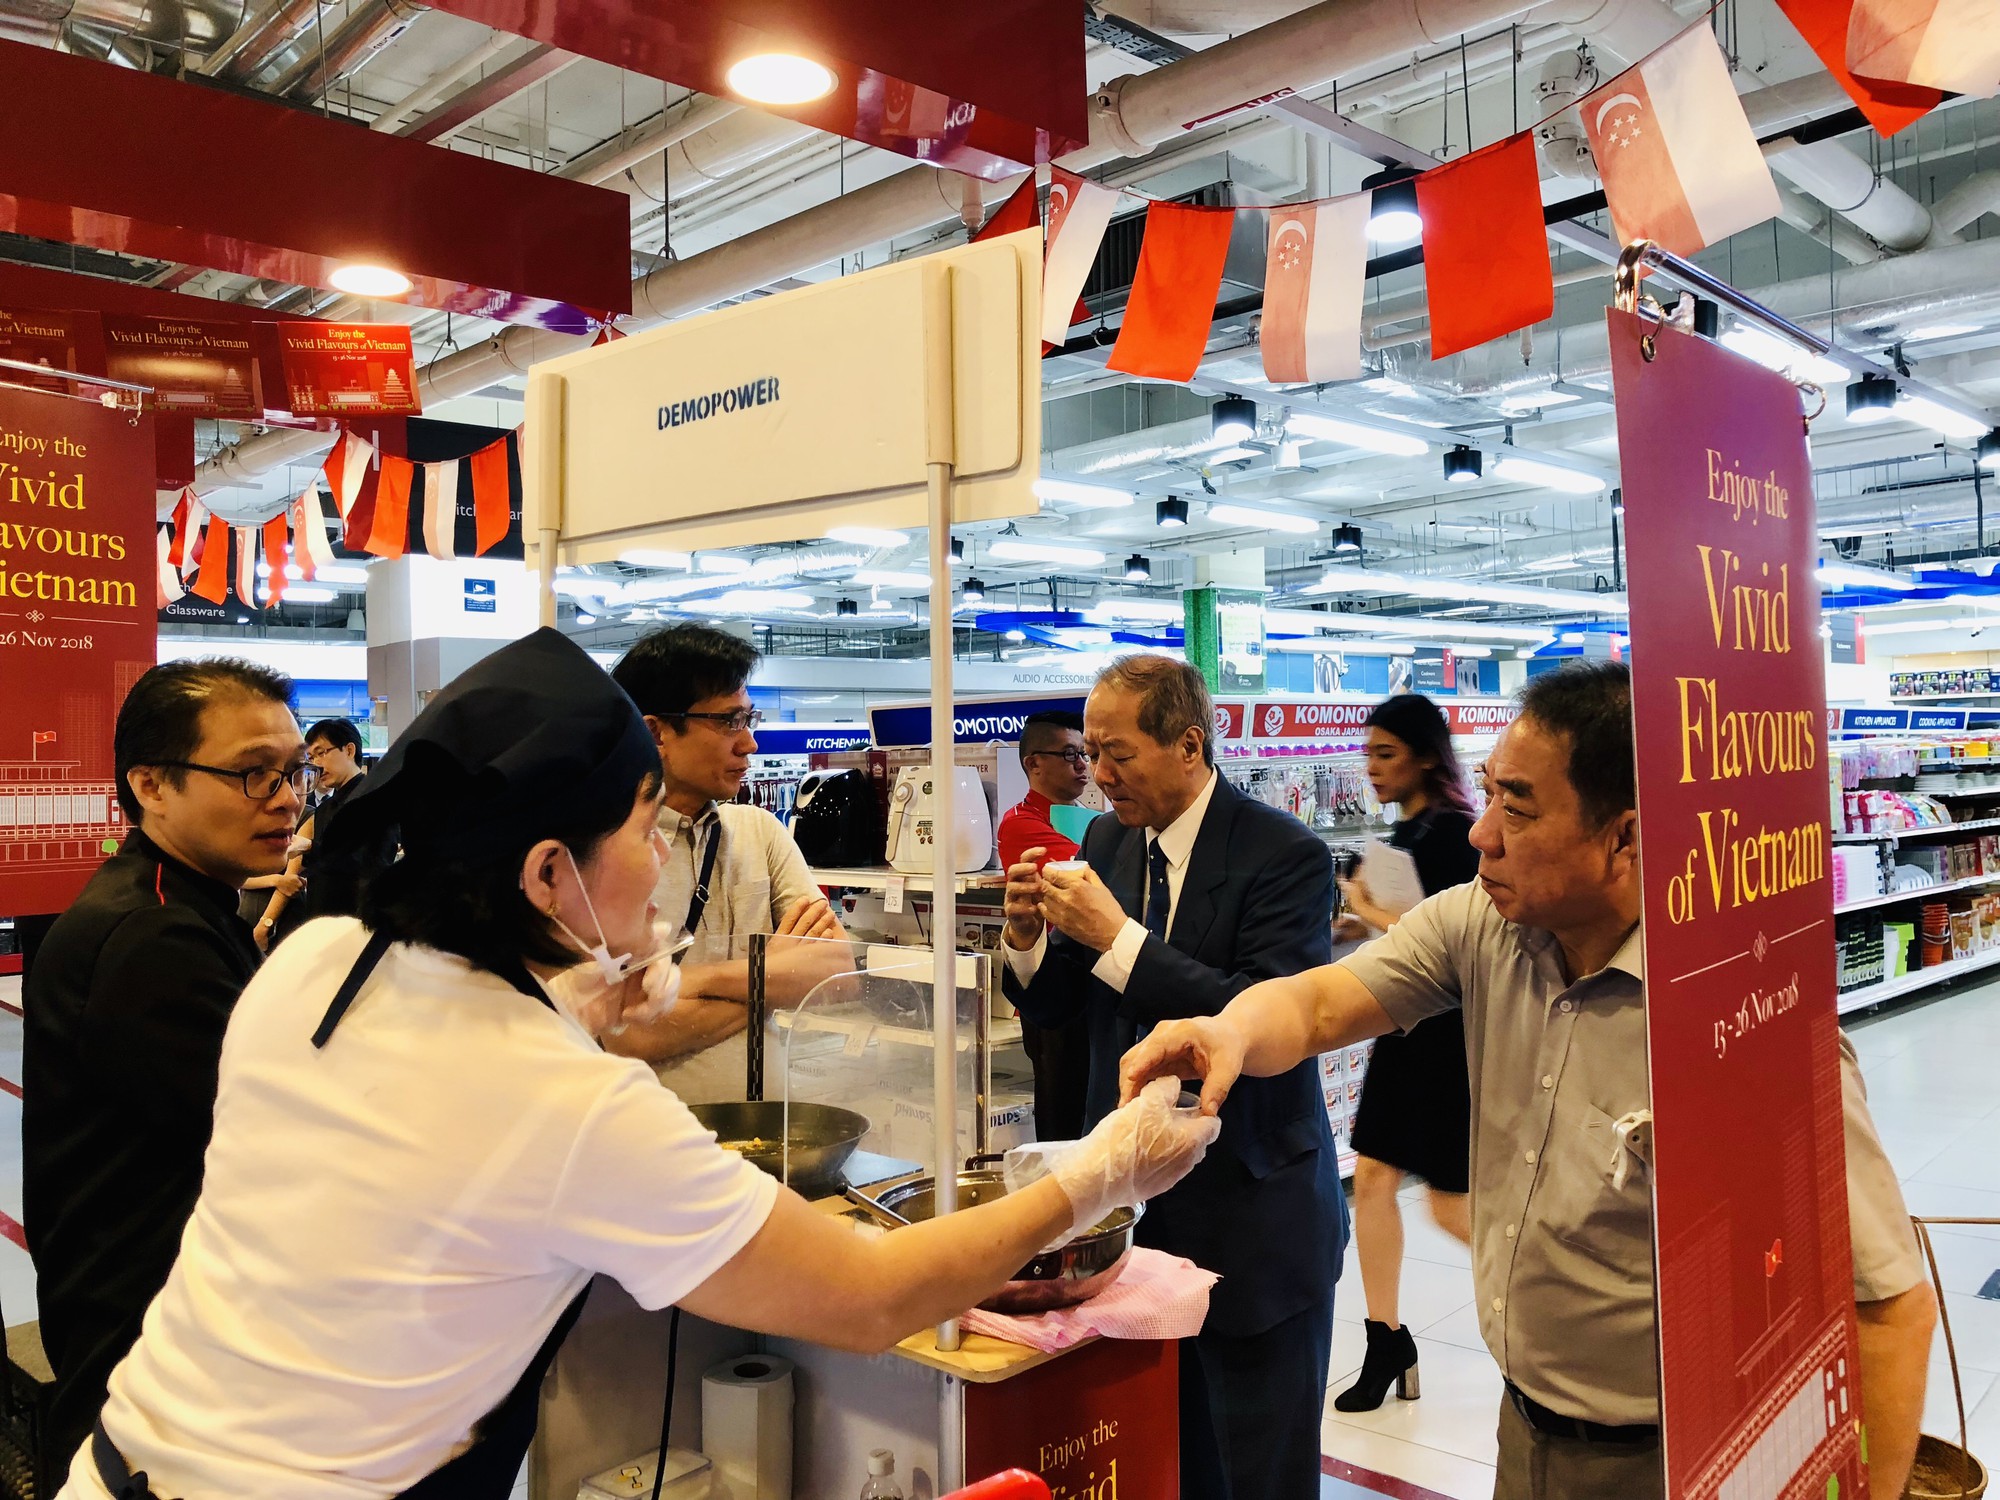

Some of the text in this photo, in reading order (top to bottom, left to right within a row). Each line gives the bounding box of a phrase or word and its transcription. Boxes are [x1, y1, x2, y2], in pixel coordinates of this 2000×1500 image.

[0, 310, 12, 320] he
[13, 322, 65, 337] Vietnam
[158, 323, 201, 335] Enjoy the
[328, 329, 366, 340] Enjoy the
[111, 331, 142, 343] Vivid
[145, 332, 194, 346] Flavours
[203, 336, 249, 349] Vietnam
[287, 338, 314, 349] Vivid
[316, 338, 359, 350] Flavours
[366, 339, 406, 351] Vietnam
[658, 376, 780, 430] DEMOPOWER
[54, 436, 87, 458] the
[1706, 448, 1789, 526] Enjoy the
[0, 521, 126, 561] avours
[0, 559, 138, 607] ietnam
[1696, 544, 1791, 654] Vivid
[166, 603, 226, 617] Glassware
[21, 631, 56, 648] Nov
[61, 635, 93, 650] 2018
[1446, 652, 1452, 666] 3
[1013, 673, 1041, 684] AUDIO
[1458, 706, 1519, 724] KOMONO
[953, 715, 1029, 736] OMOTION
[1314, 727, 1366, 736] OSAKA JAPAN
[1473, 725, 1493, 734] OSAKA
[1675, 676, 1816, 784] Flavours
[806, 737, 873, 749] KITCHENWA
[1667, 808, 1824, 925] of Vietnam
[1751, 988, 1776, 1029] Nov
[1777, 971, 1799, 1015] 2018
[1040, 1419, 1118, 1473] Enjoy the
